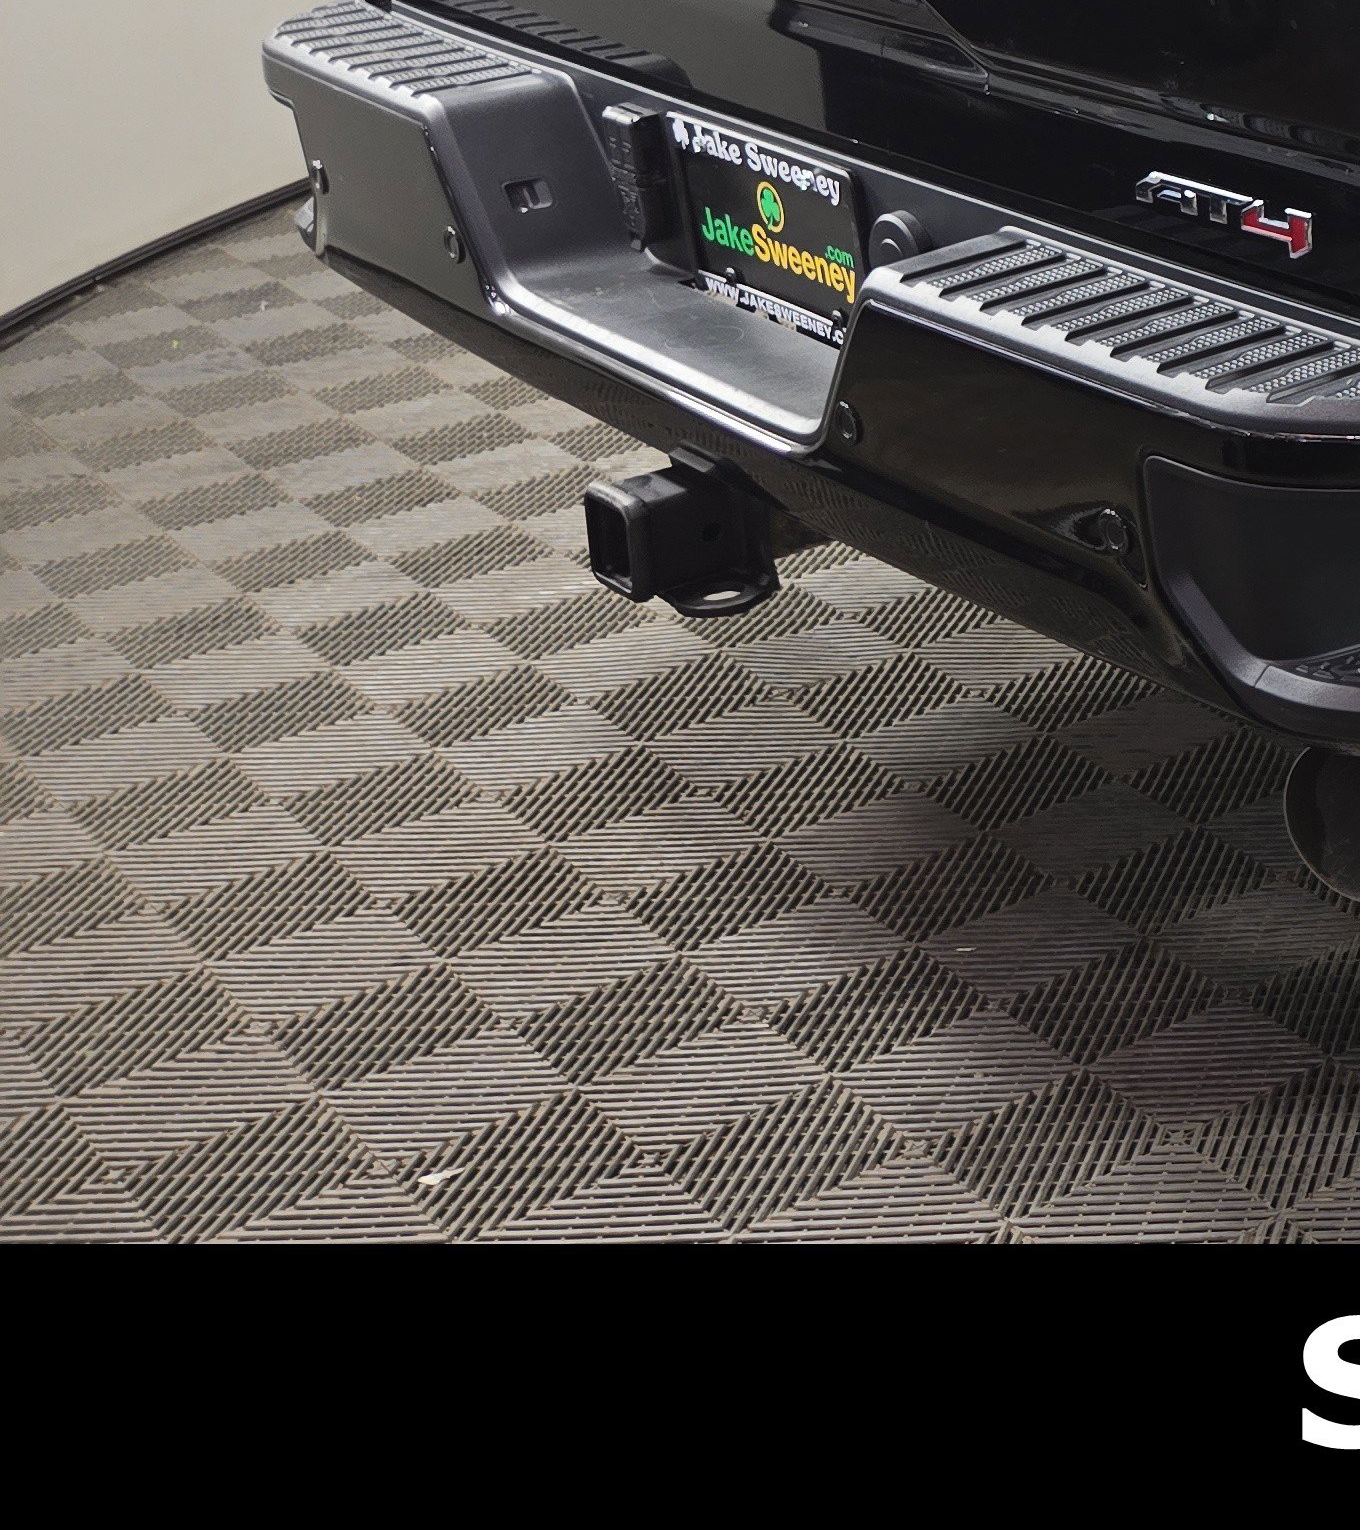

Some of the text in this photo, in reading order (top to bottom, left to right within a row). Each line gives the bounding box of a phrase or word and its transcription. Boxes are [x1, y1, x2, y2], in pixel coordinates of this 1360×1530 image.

[692, 123, 841, 207] Jake Sweeney
[1135, 170, 1313, 260] AT4
